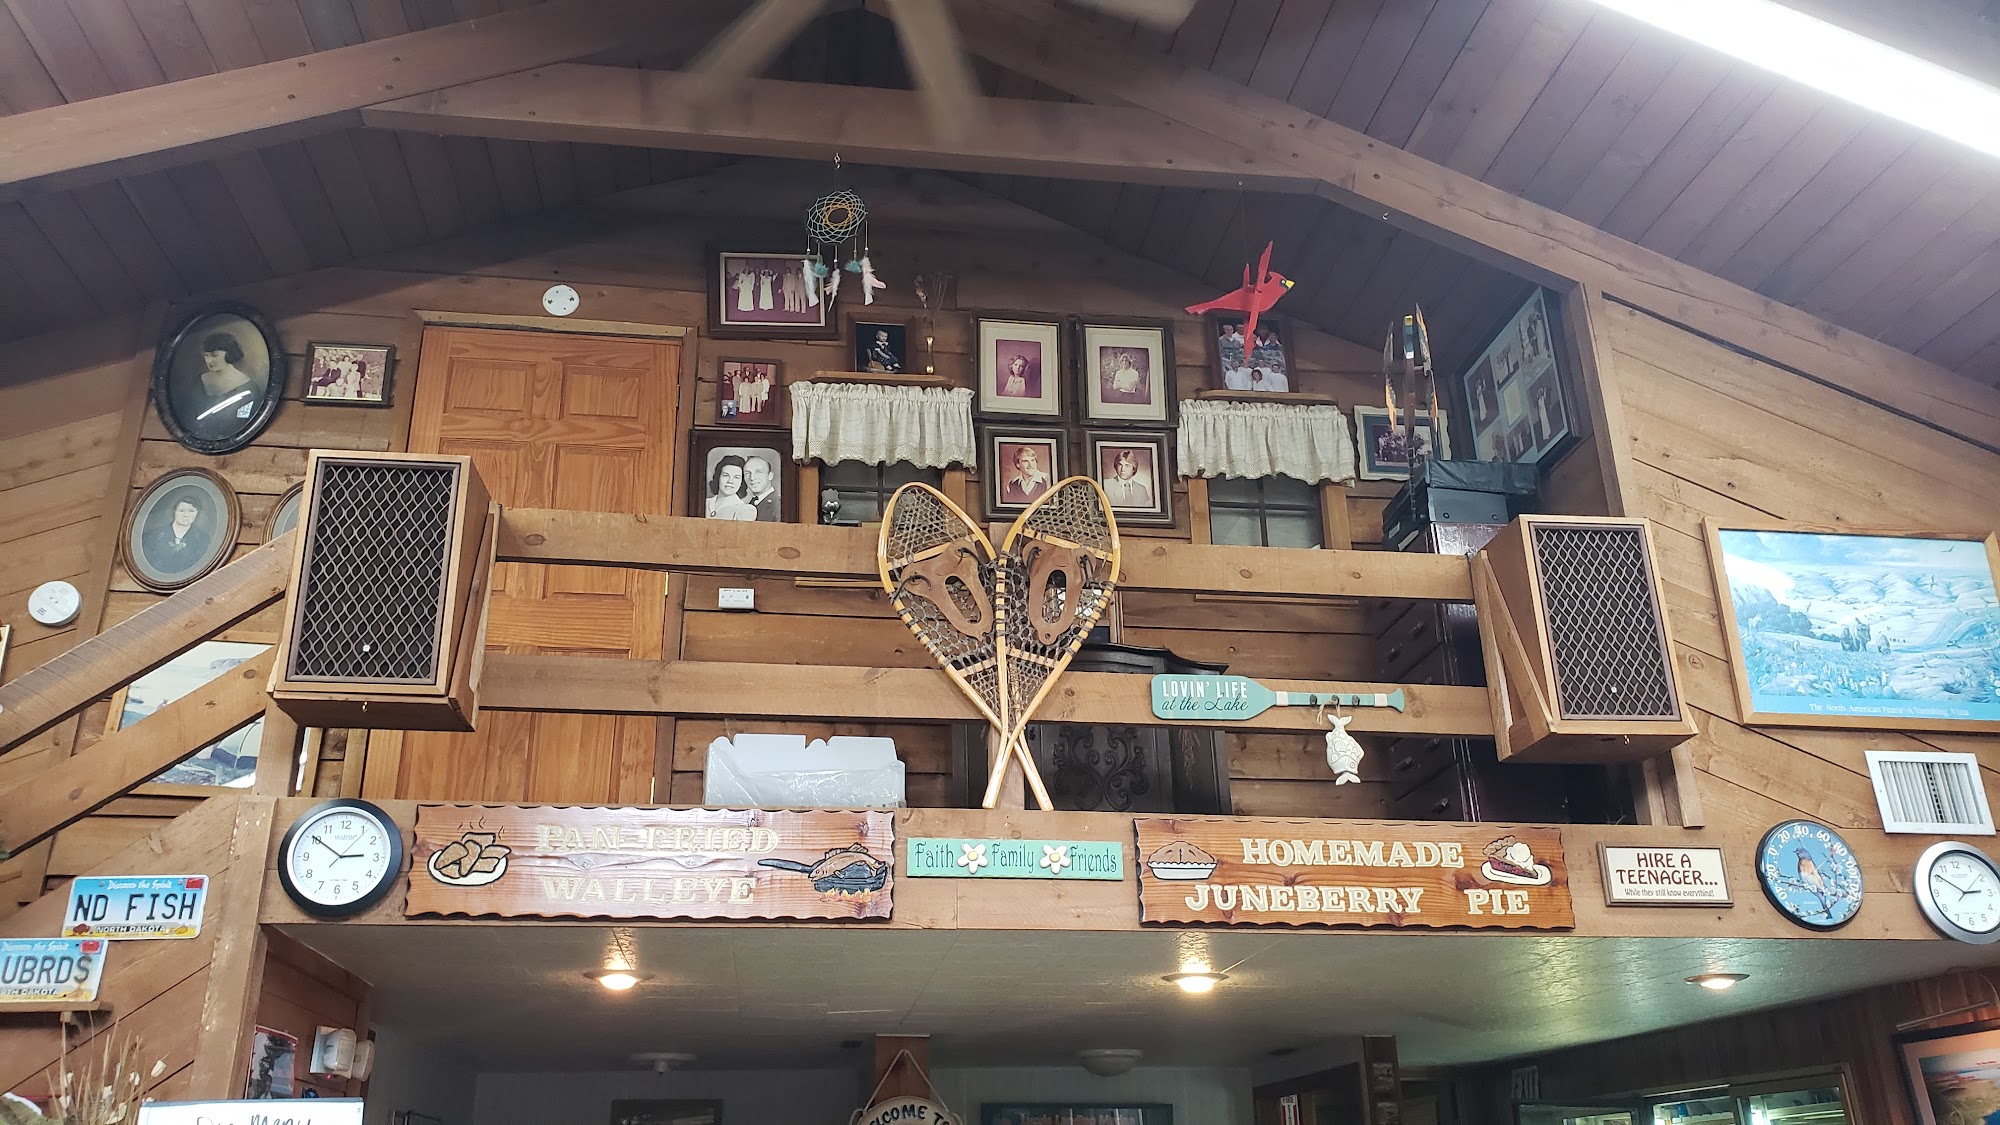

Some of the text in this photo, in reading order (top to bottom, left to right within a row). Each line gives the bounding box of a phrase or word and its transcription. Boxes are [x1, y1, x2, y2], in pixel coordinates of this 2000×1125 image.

[1162, 680, 1248, 698] LOVIN' LIFE
[1161, 692, 1249, 711] at the Lake
[1809, 703, 1823, 711] The
[1826, 704, 1846, 712] North
[1848, 705, 1881, 713] American
[324, 825, 333, 834] 11
[341, 820, 352, 830] 12
[370, 836, 377, 845] 2
[535, 823, 780, 854] PAN-FRIED
[1816, 830, 1830, 842] 60
[303, 852, 310, 861] 9
[373, 853, 380, 862] 3
[915, 841, 1117, 874] Faith Family Friends
[1240, 838, 1464, 868] HOMEMADE
[1637, 852, 1692, 868] HIRE A
[1940, 865, 1947, 873] 11
[1950, 861, 1960, 869] 12
[306, 869, 313, 878] 8
[366, 870, 372, 878] 4
[1616, 869, 1718, 886] TEENAGER...
[1979, 874, 1985, 882] 2
[107, 880, 172, 890] Discover the Spirit
[318, 881, 325, 890] 7
[334, 885, 341, 894] 6
[352, 881, 359, 890] 5
[541, 875, 756, 905] WALLEYE
[1625, 888, 1640, 896] While
[1642, 888, 1654, 897] they
[1655, 888, 1666, 896] still
[1934, 889, 1939, 897] 9
[1987, 889, 1993, 897] 3
[1185, 885, 1530, 915] JUNEBERRY PIE
[73, 893, 197, 921] ND FISH
[1942, 904, 1948, 912] 8
[1988, 903, 1993, 911] 4
[1954, 914, 1960, 922] 7
[1968, 917, 1975, 925] 6
[1981, 914, 1987, 922] 5
[1, 954, 93, 984] UBRDS
[869, 1104, 928, 1125] LCOME
